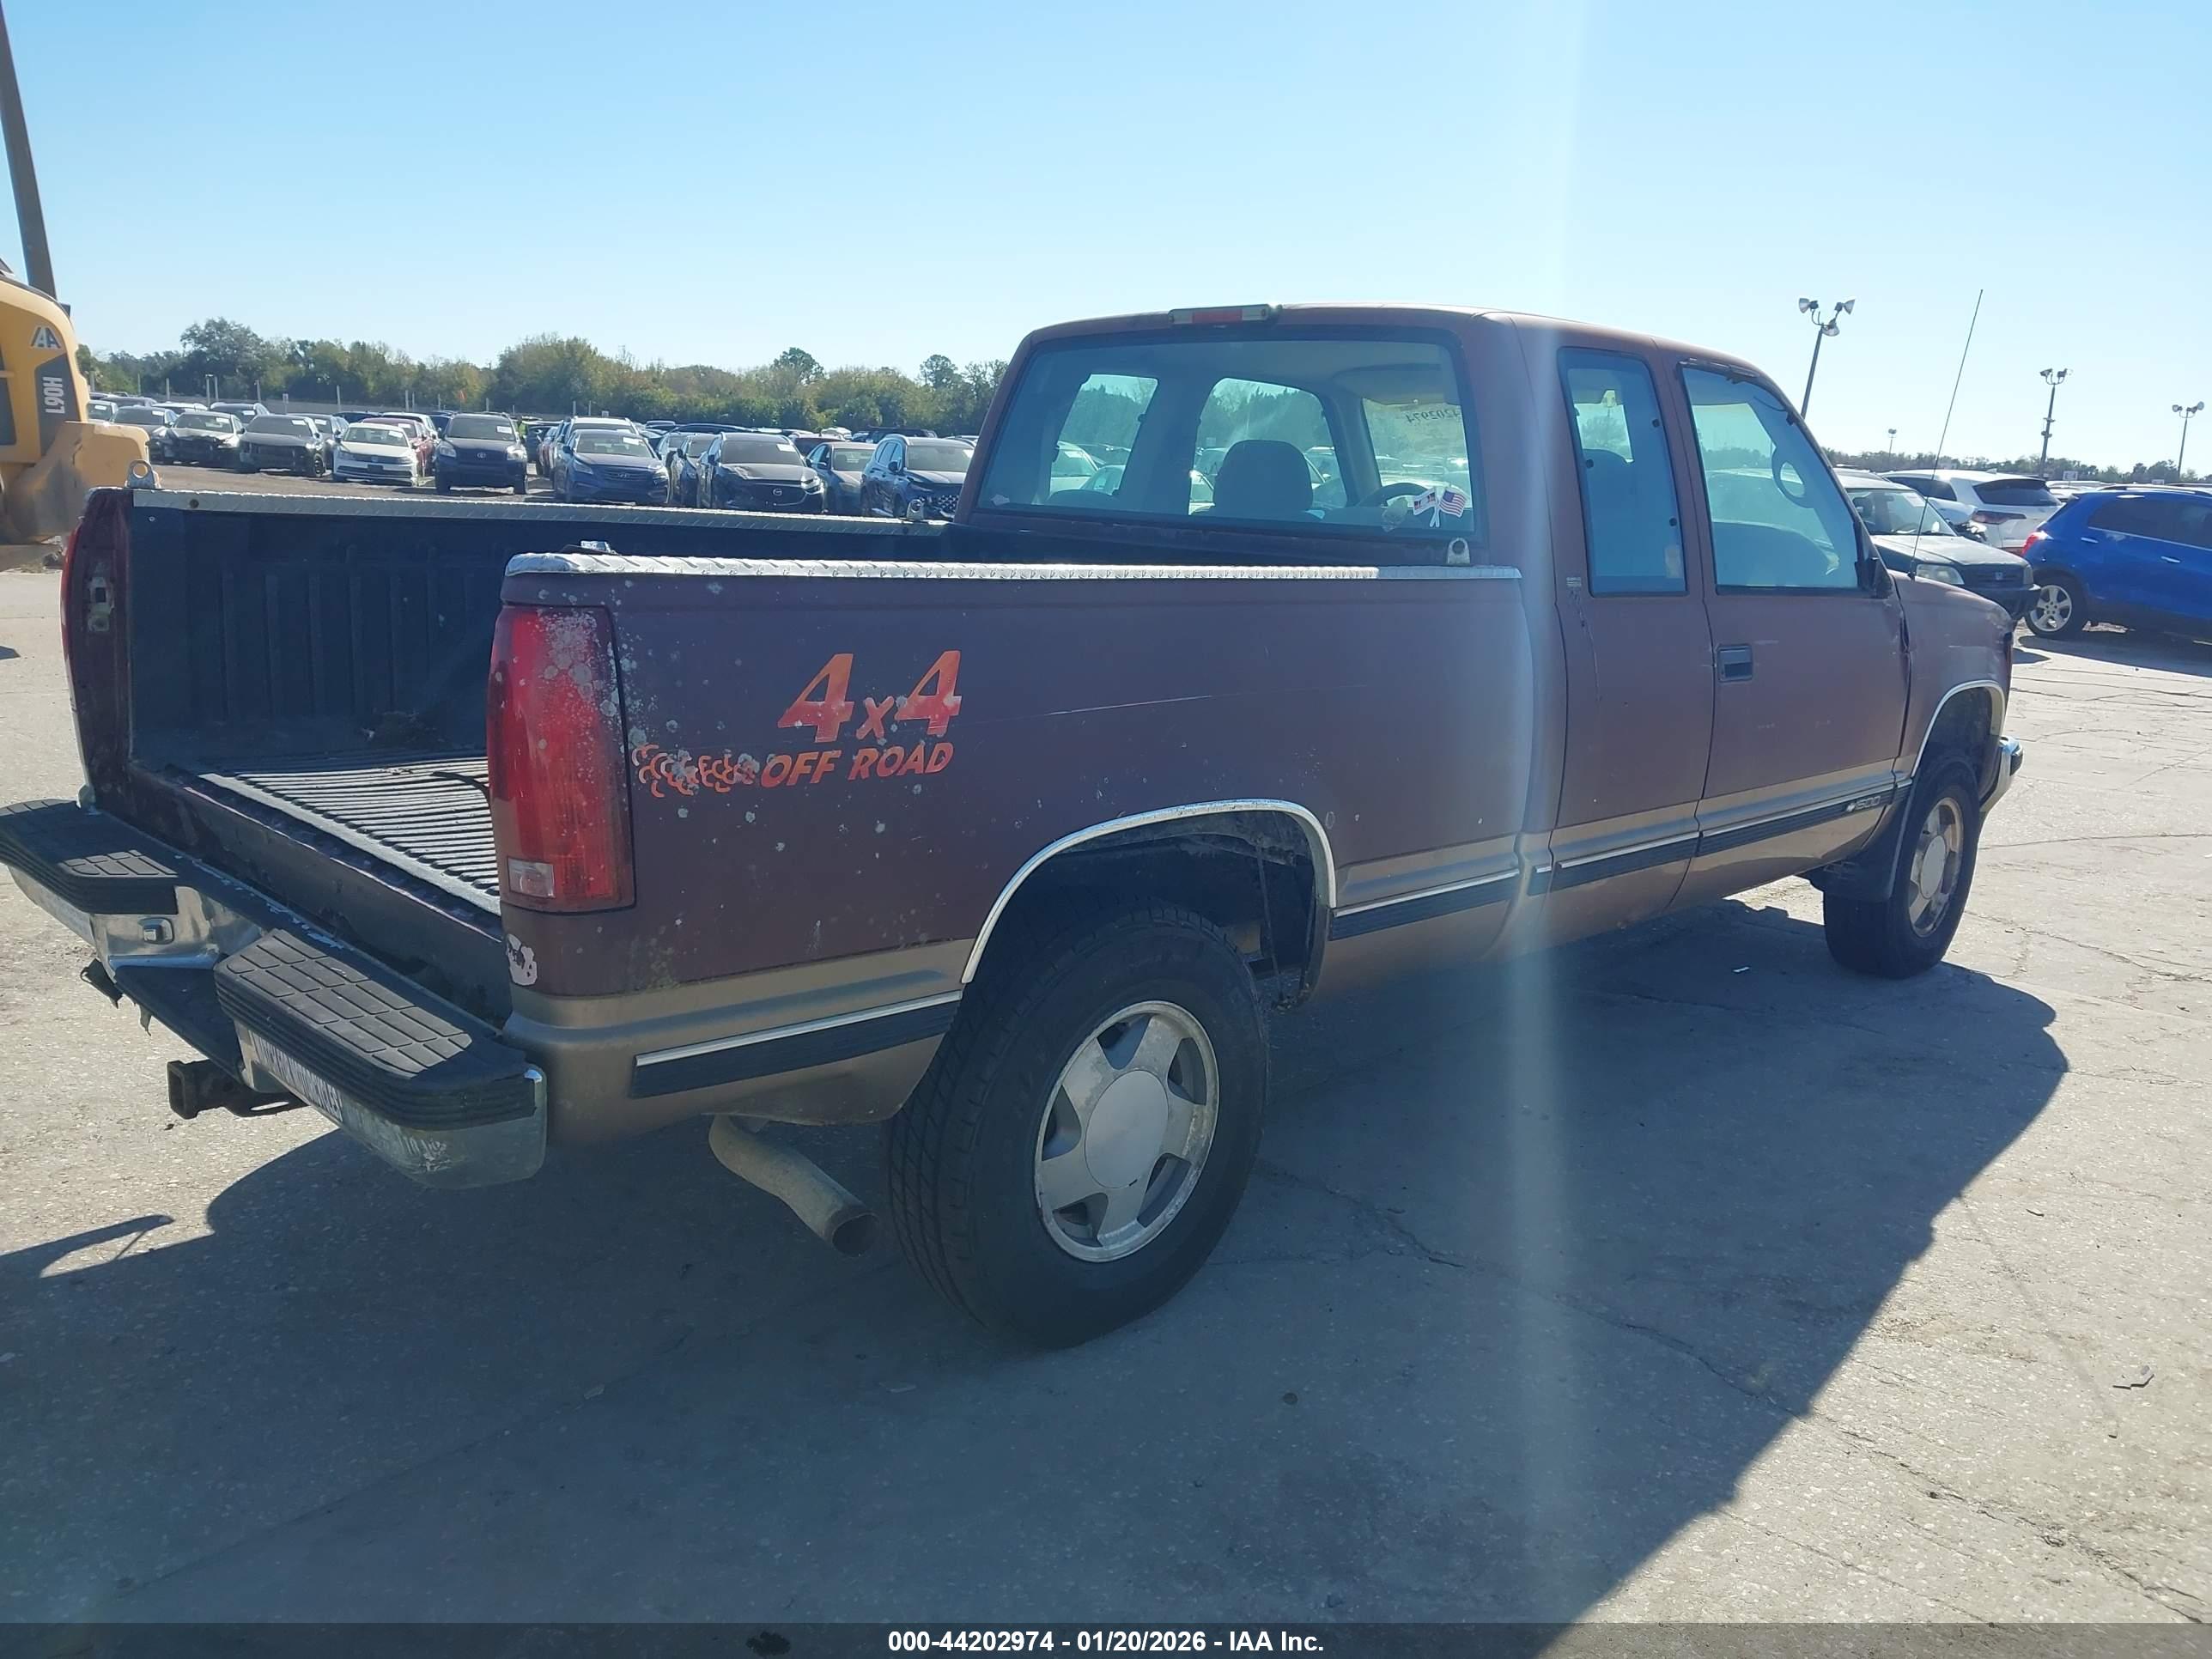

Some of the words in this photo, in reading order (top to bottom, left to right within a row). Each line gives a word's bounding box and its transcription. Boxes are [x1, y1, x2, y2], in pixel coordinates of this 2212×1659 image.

[42, 376, 66, 415] L90H
[760, 750, 842, 788] OFF
[848, 742, 955, 781] ROAD
